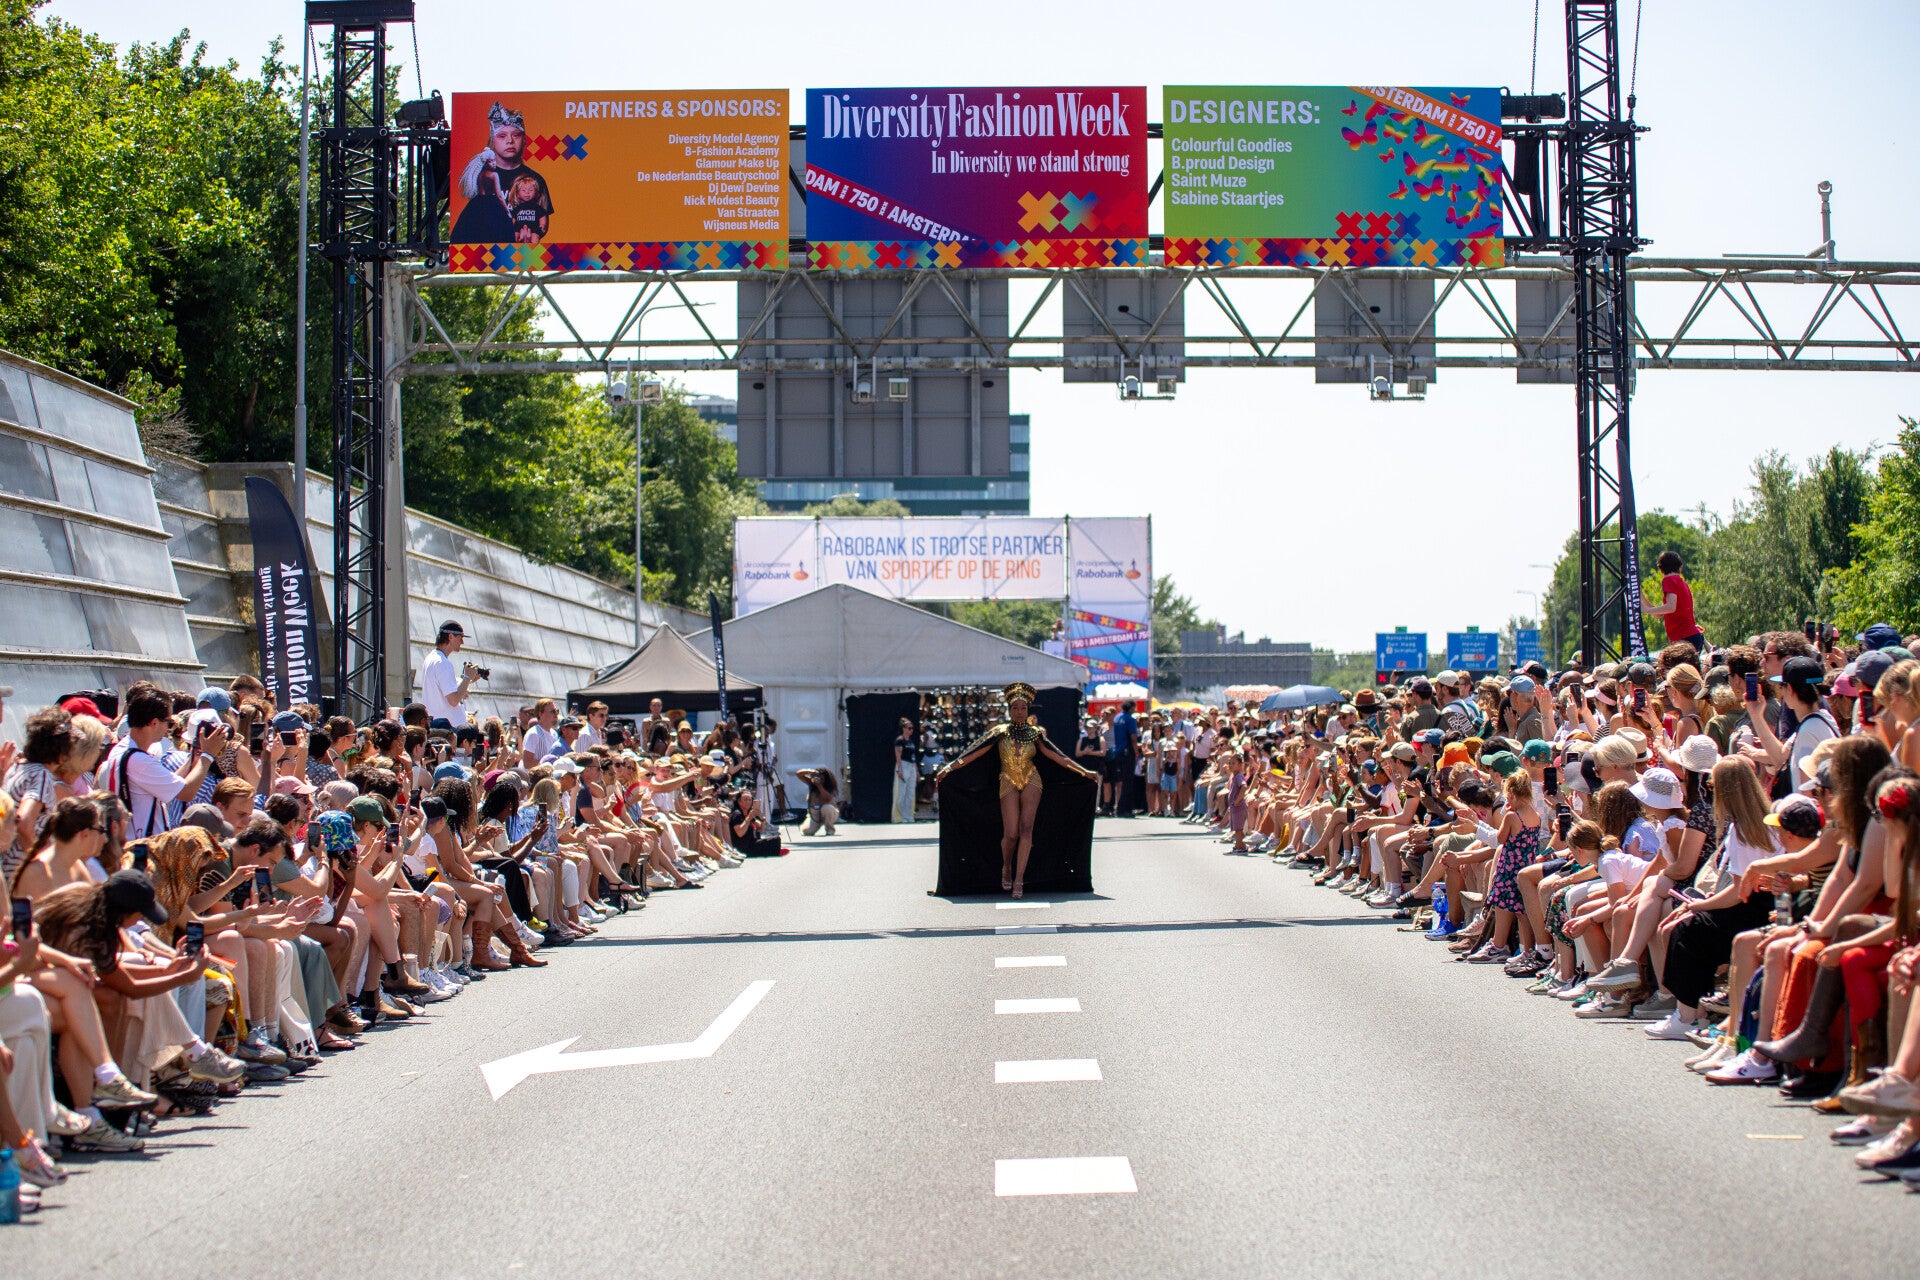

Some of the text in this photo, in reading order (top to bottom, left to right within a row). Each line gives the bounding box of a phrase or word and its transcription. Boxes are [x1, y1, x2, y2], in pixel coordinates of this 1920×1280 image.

[566, 100, 781, 118] PARTNERS & SPONSORS:
[1171, 100, 1320, 124] DESIGNERS:
[1360, 86, 1486, 140] MSTERDAM 750
[823, 93, 1129, 147] DiversityFashionWeek
[669, 133, 779, 145] Diversity Model Agency
[1172, 138, 1292, 152] Colourful Goodies
[685, 146, 779, 158] B-Fashion Academy
[696, 158, 779, 169] Glamour Make Up
[932, 150, 1129, 177] In Diversity we stand strong
[1172, 156, 1274, 173] B.proud Design
[638, 170, 779, 182] De Nederlandse Beautyschool
[1172, 173, 1246, 187] Saint Muze
[709, 183, 779, 194] Dj Dewi Devine
[684, 195, 779, 207] Nick Modest Beauty
[806, 169, 976, 241] DAM 750 AMSTERD
[1172, 191, 1284, 208] Sabine Staartjes
[718, 208, 779, 217] Van Straaten
[704, 220, 779, 231] Wijsneus Media
[823, 535, 1063, 556] RABOBANK IS TROTSE PARTNER
[744, 570, 791, 580] Rabobank
[845, 559, 1041, 580] VAN SPORTIEF OP DE RING
[1076, 569, 1124, 579] Rabobank
[1089, 632, 1133, 646] AMSTERDAM
